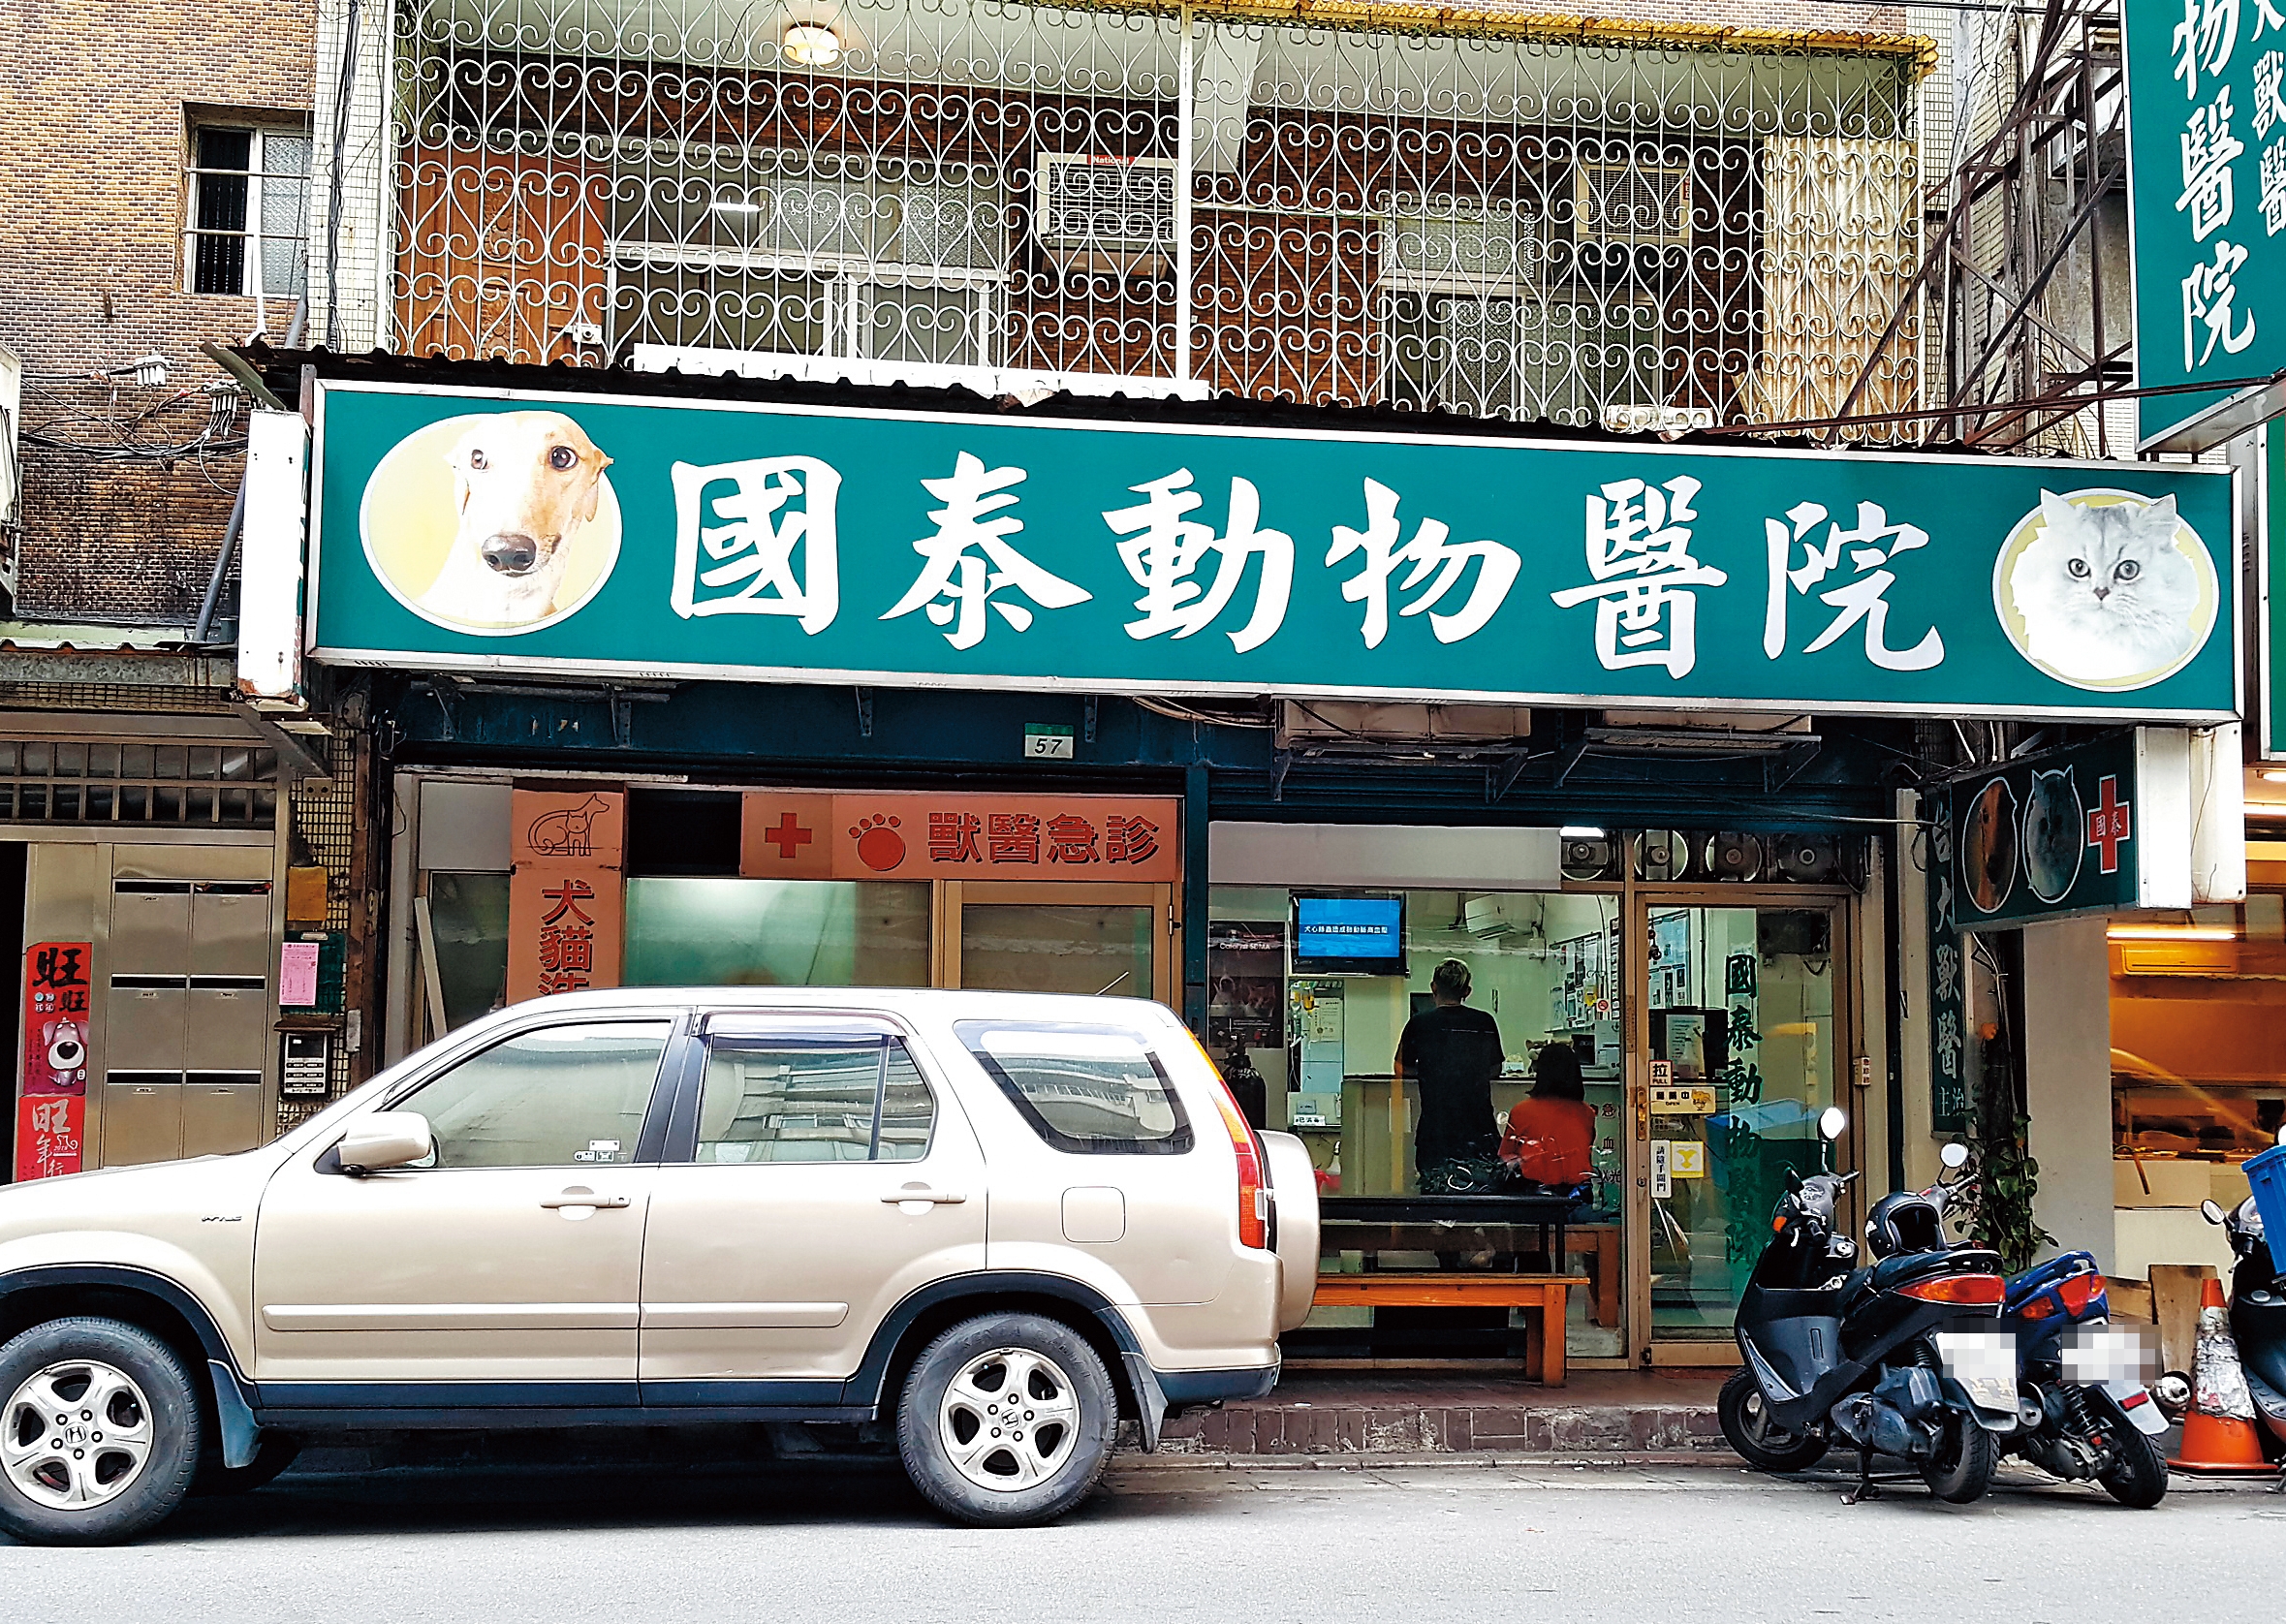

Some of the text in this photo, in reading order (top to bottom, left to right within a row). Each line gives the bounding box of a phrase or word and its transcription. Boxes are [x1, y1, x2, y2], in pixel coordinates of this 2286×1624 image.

[671, 450, 1946, 680] 國泰動物醫院
[1034, 737, 1063, 755] 57
[927, 812, 1160, 865] 獸醫急診
[1652, 1063, 1668, 1077] 拉
